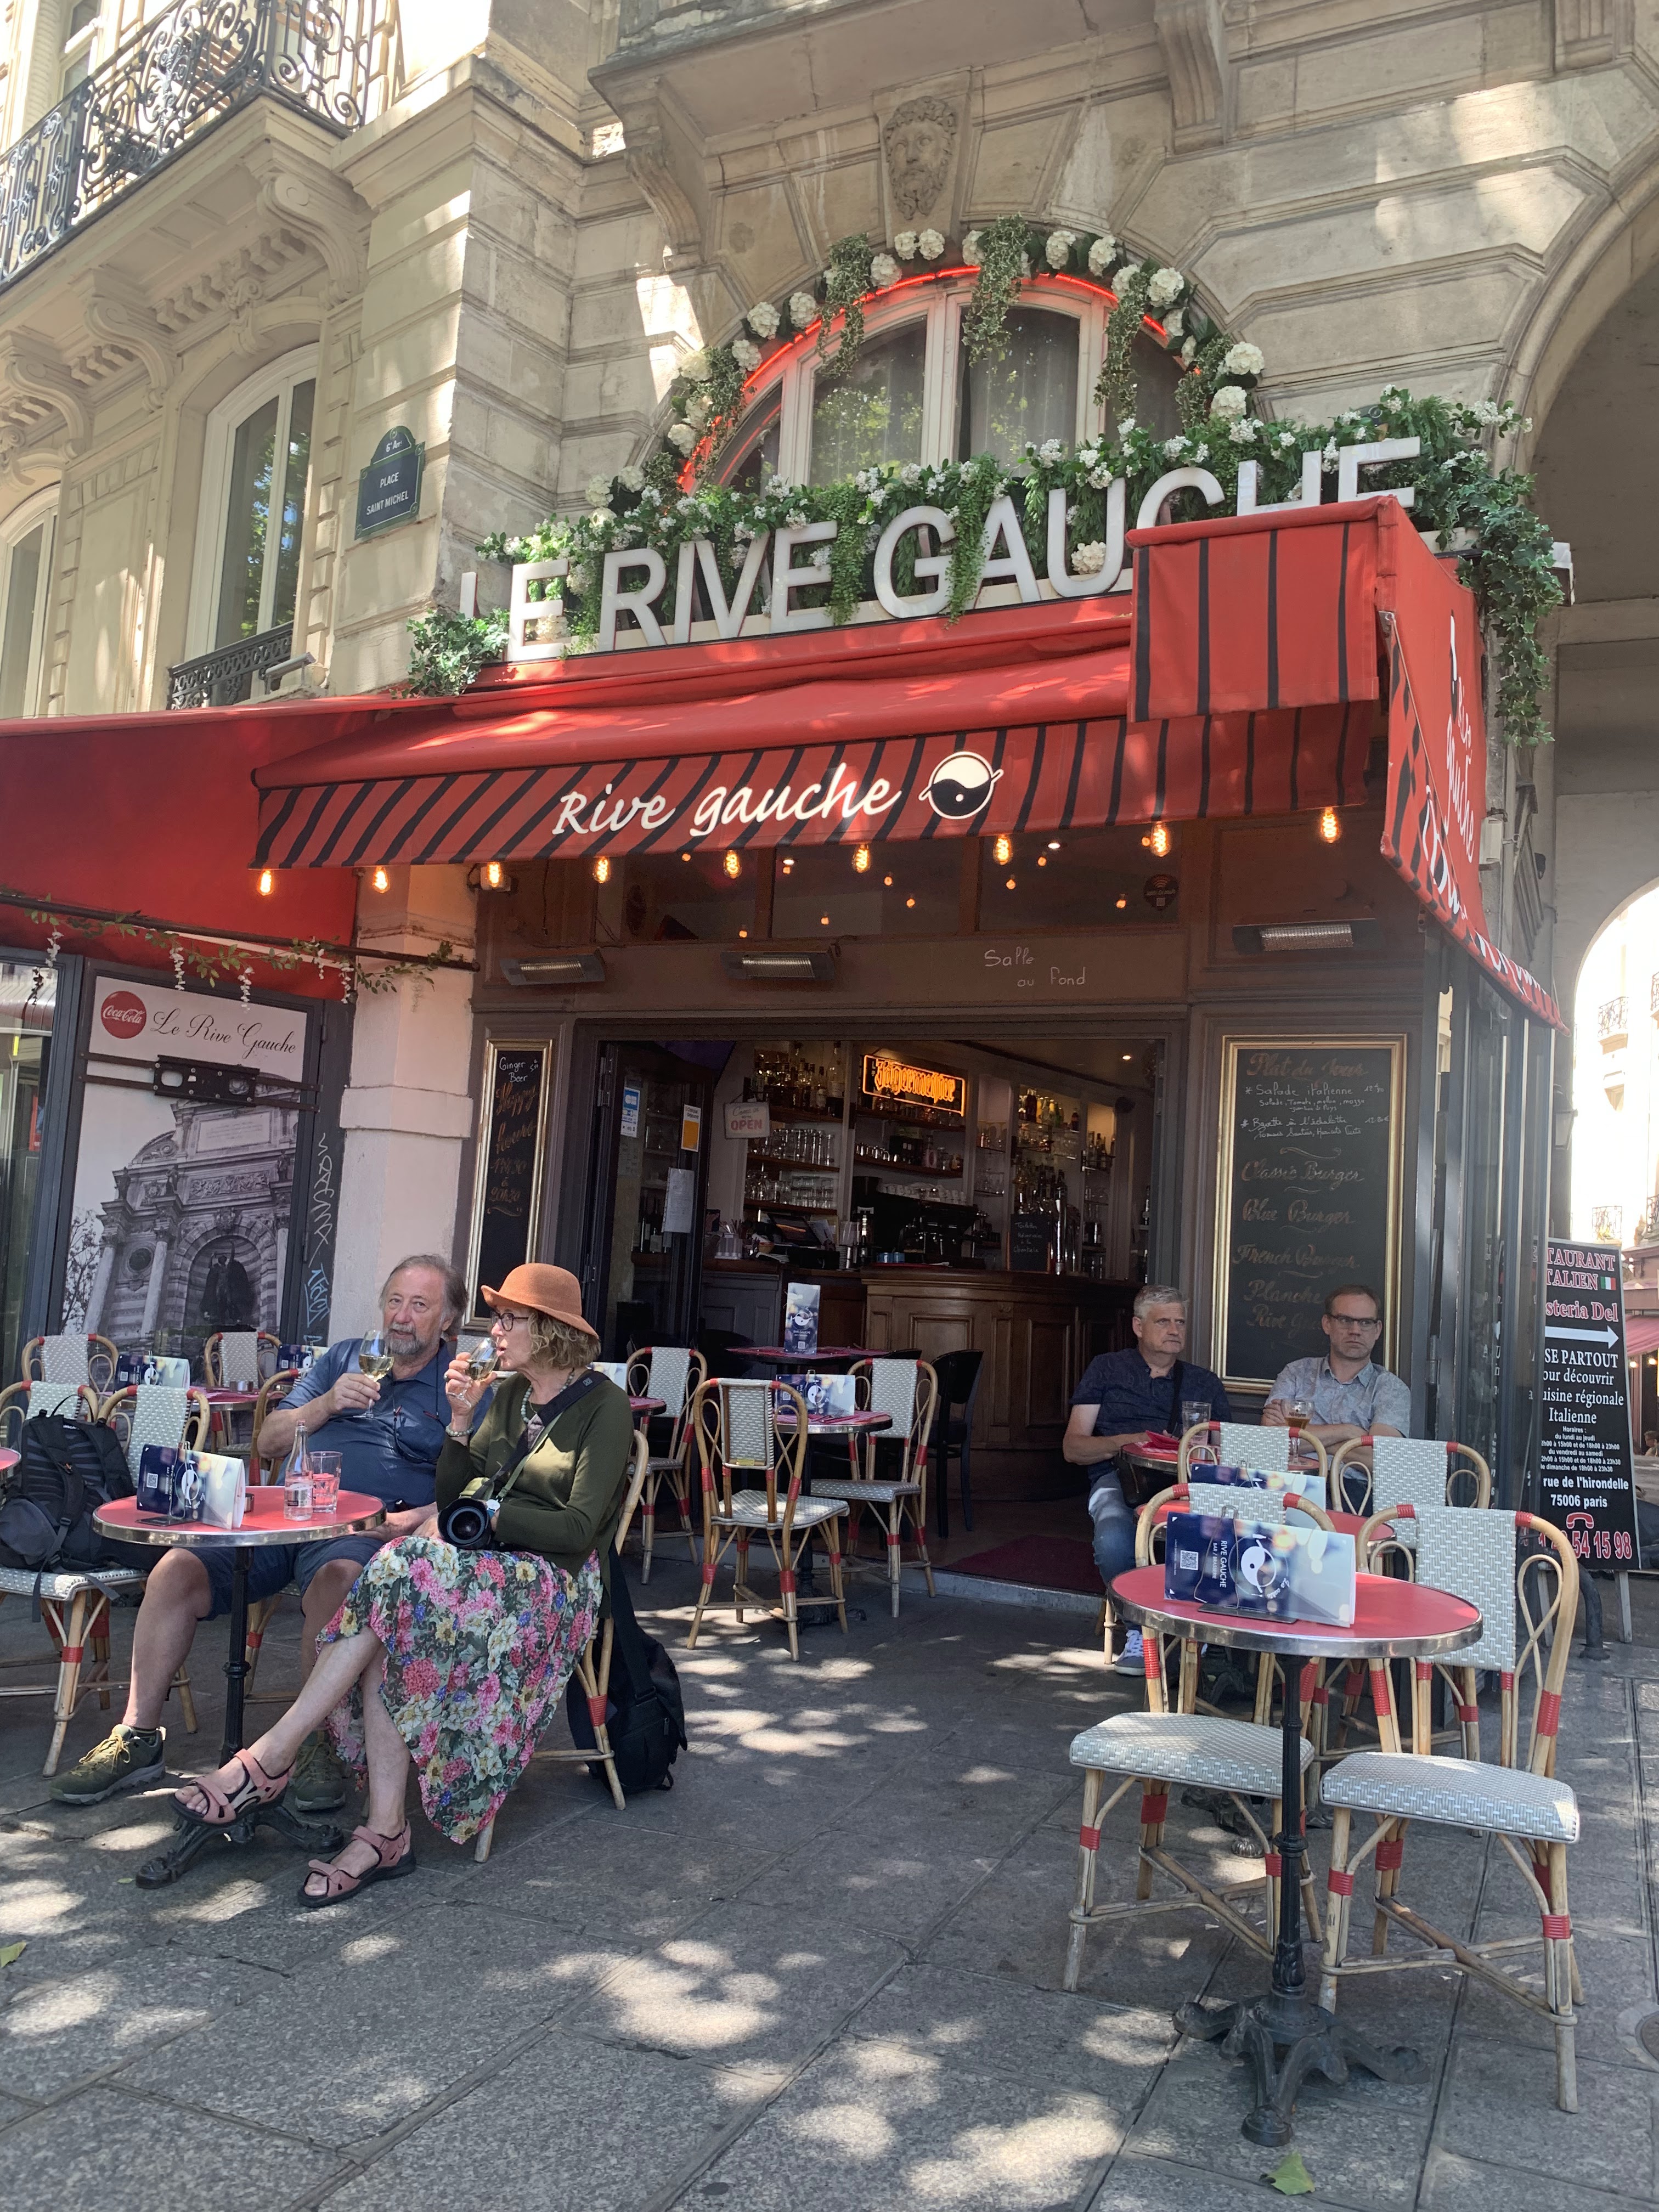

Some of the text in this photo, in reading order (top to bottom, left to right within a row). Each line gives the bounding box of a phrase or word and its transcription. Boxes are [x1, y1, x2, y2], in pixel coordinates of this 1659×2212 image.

[380, 472, 399, 488] PLACE
[366, 490, 409, 515] SAINT MICHEL
[598, 521, 837, 653] RIVE
[873, 436, 1420, 619] GAUCHE
[552, 762, 902, 837] Rive gauche
[984, 946, 1034, 967] Salle
[1017, 979, 1034, 987] au
[103, 1005, 145, 1025] Coca-Cola
[150, 1008, 297, 1059] Le Rive Gauche
[499, 1057, 526, 1073] Ginger
[509, 1072, 528, 1082] Beer
[1256, 1082, 1299, 1096] Salade
[1307, 1082, 1353, 1096] italienne
[731, 1119, 763, 1130] OPEN
[1299, 1160, 1365, 1192] Burger
[1288, 1199, 1357, 1233] Burger
[1547, 1248, 1616, 1271] TAURANT
[1546, 1269, 1599, 1290] TALIEN
[1545, 1300, 1618, 1322] steria Del
[1561, 1350, 1618, 1368] PARTOUT
[1543, 1368, 1614, 1385] our découvrir
[1543, 1387, 1572, 1402] uisine
[1575, 1389, 1624, 1408] régionale
[1549, 1407, 1597, 1424] Italienne
[1543, 1477, 1559, 1487] rue
[1562, 1476, 1574, 1488] de
[1577, 1476, 1629, 1490] l'hirondelle
[1550, 1493, 1608, 1510] 75006 paris
[1572, 1530, 1590, 1559] 54
[1594, 1531, 1611, 1559] 15
[1613, 1531, 1632, 1559] 98
